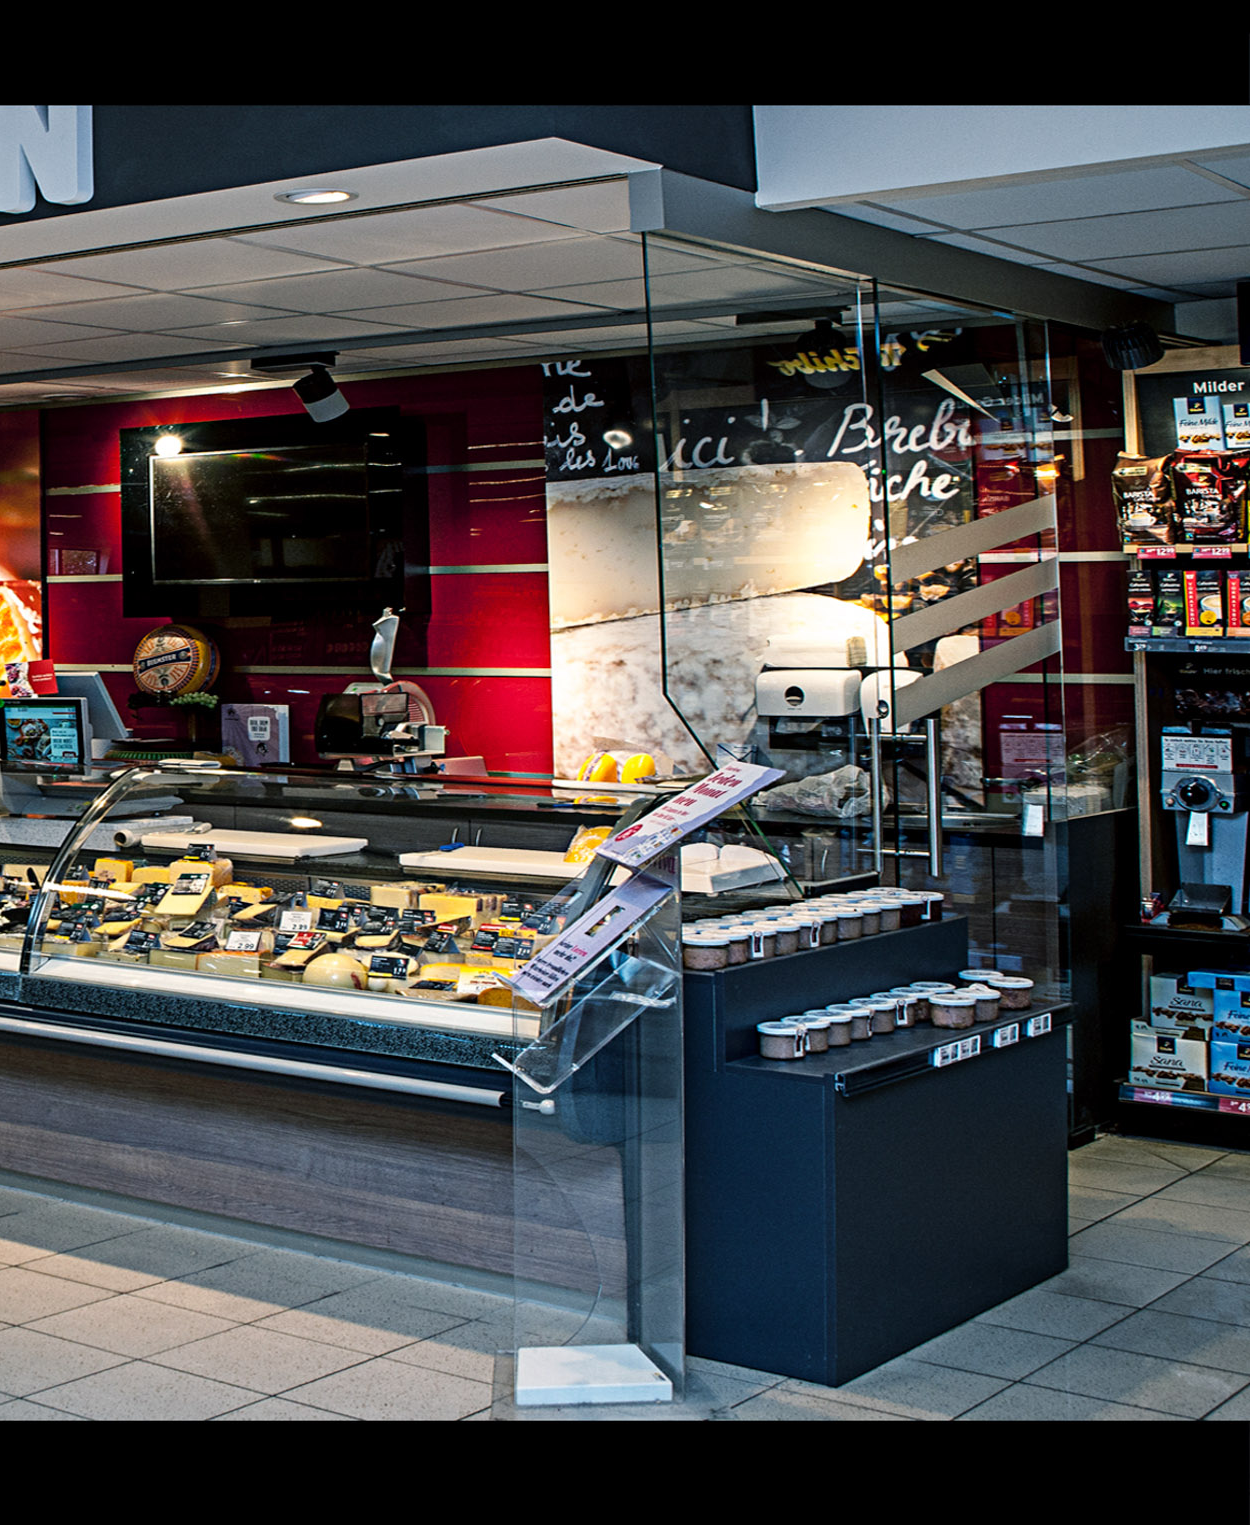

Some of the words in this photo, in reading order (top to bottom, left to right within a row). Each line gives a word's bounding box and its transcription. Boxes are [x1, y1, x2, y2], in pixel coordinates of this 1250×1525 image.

[1193, 380, 1246, 394] Milder
[553, 384, 605, 413] de
[658, 416, 736, 471] ici
[559, 447, 596, 471] les
[707, 772, 742, 788] Jeden
[692, 783, 729, 799] Monat
[1170, 996, 1203, 1008] Sana
[1150, 1056, 1184, 1067] Sana
